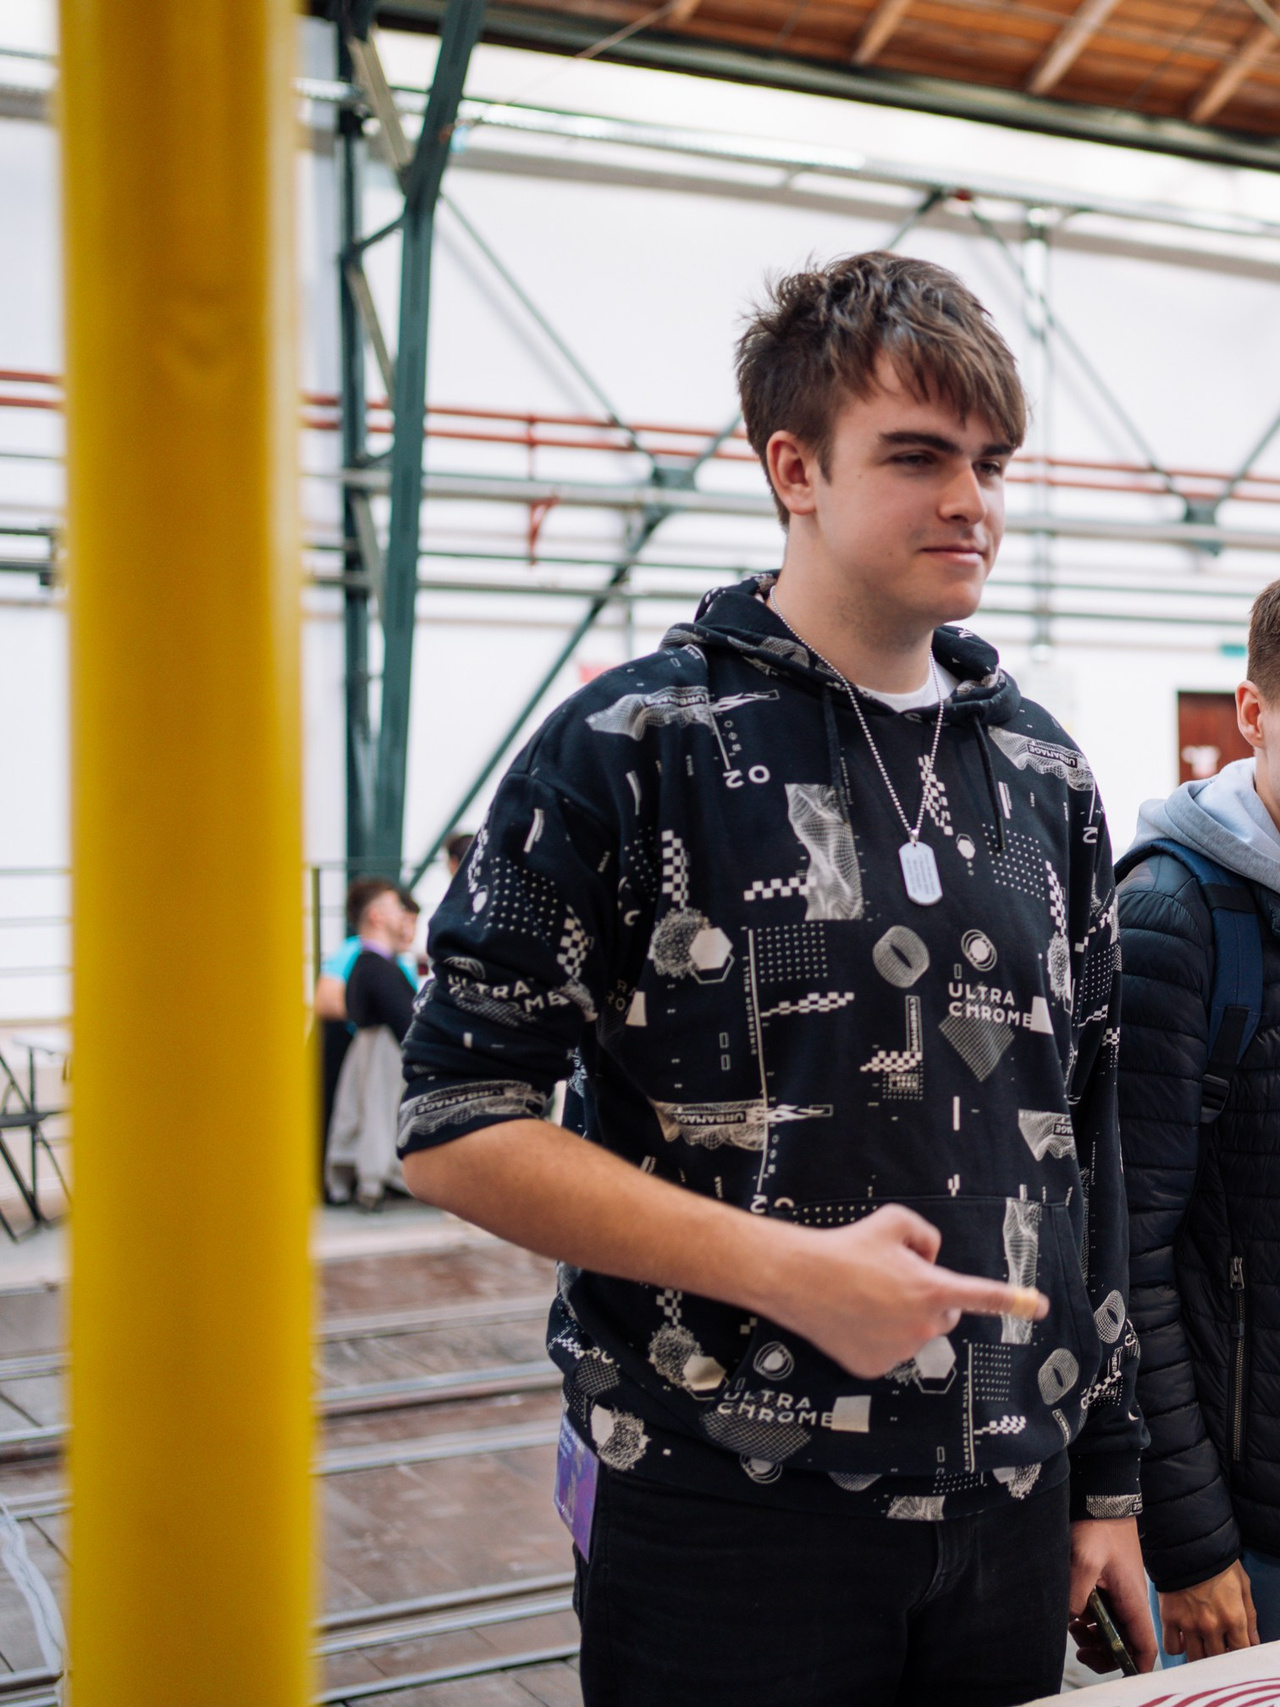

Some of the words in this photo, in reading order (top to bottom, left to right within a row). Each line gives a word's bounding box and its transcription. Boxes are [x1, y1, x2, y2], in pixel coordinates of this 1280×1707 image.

[948, 981, 1016, 1007] ULTRA
[948, 1001, 1034, 1028] CHROME
[723, 1389, 811, 1410] ULTRA
[717, 1401, 834, 1428] CHROME
